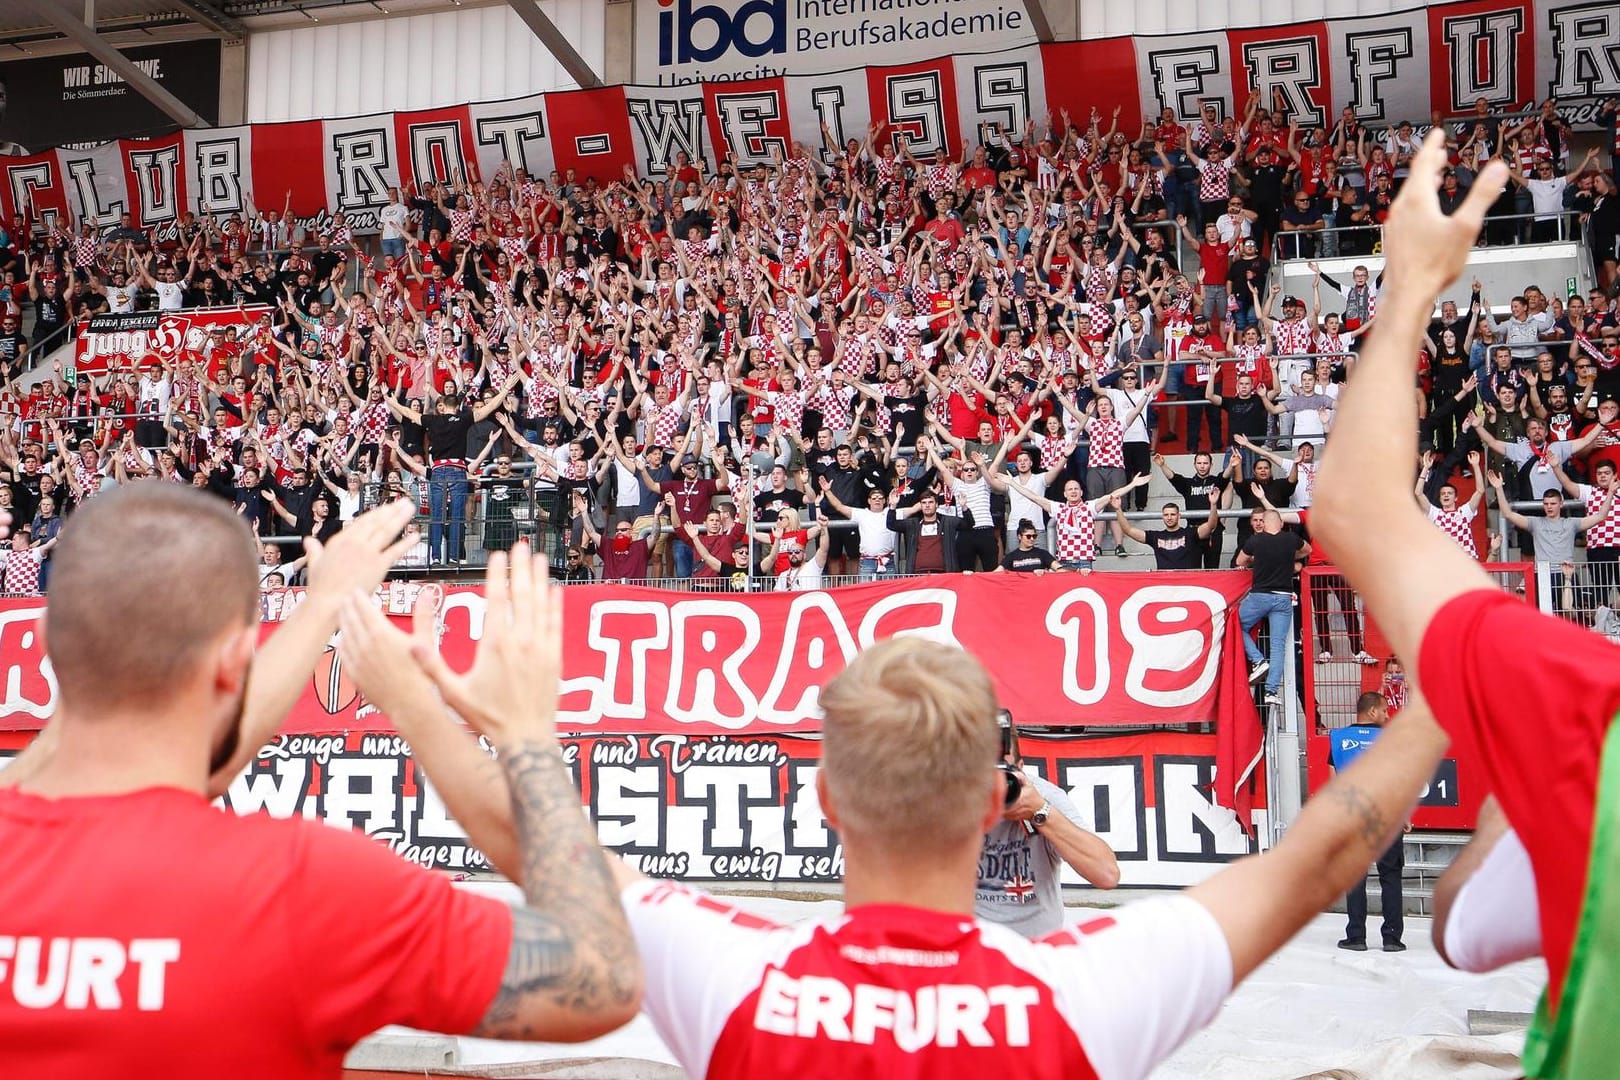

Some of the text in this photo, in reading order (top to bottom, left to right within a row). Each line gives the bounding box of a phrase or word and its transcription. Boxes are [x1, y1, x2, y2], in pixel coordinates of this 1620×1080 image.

[658, 0, 787, 67] ibd
[797, 7, 1022, 52] Berufsakademie
[63, 67, 90, 88] WIR
[94, 64, 125, 84] SIN
[63, 91, 76, 100] Die
[7, 137, 244, 238] CLUB
[1046, 585, 1229, 707] 18
[594, 736, 638, 764] und
[642, 852, 689, 875] uns
[714, 848, 780, 881] ewig
[754, 968, 1040, 1053] ERFURT
